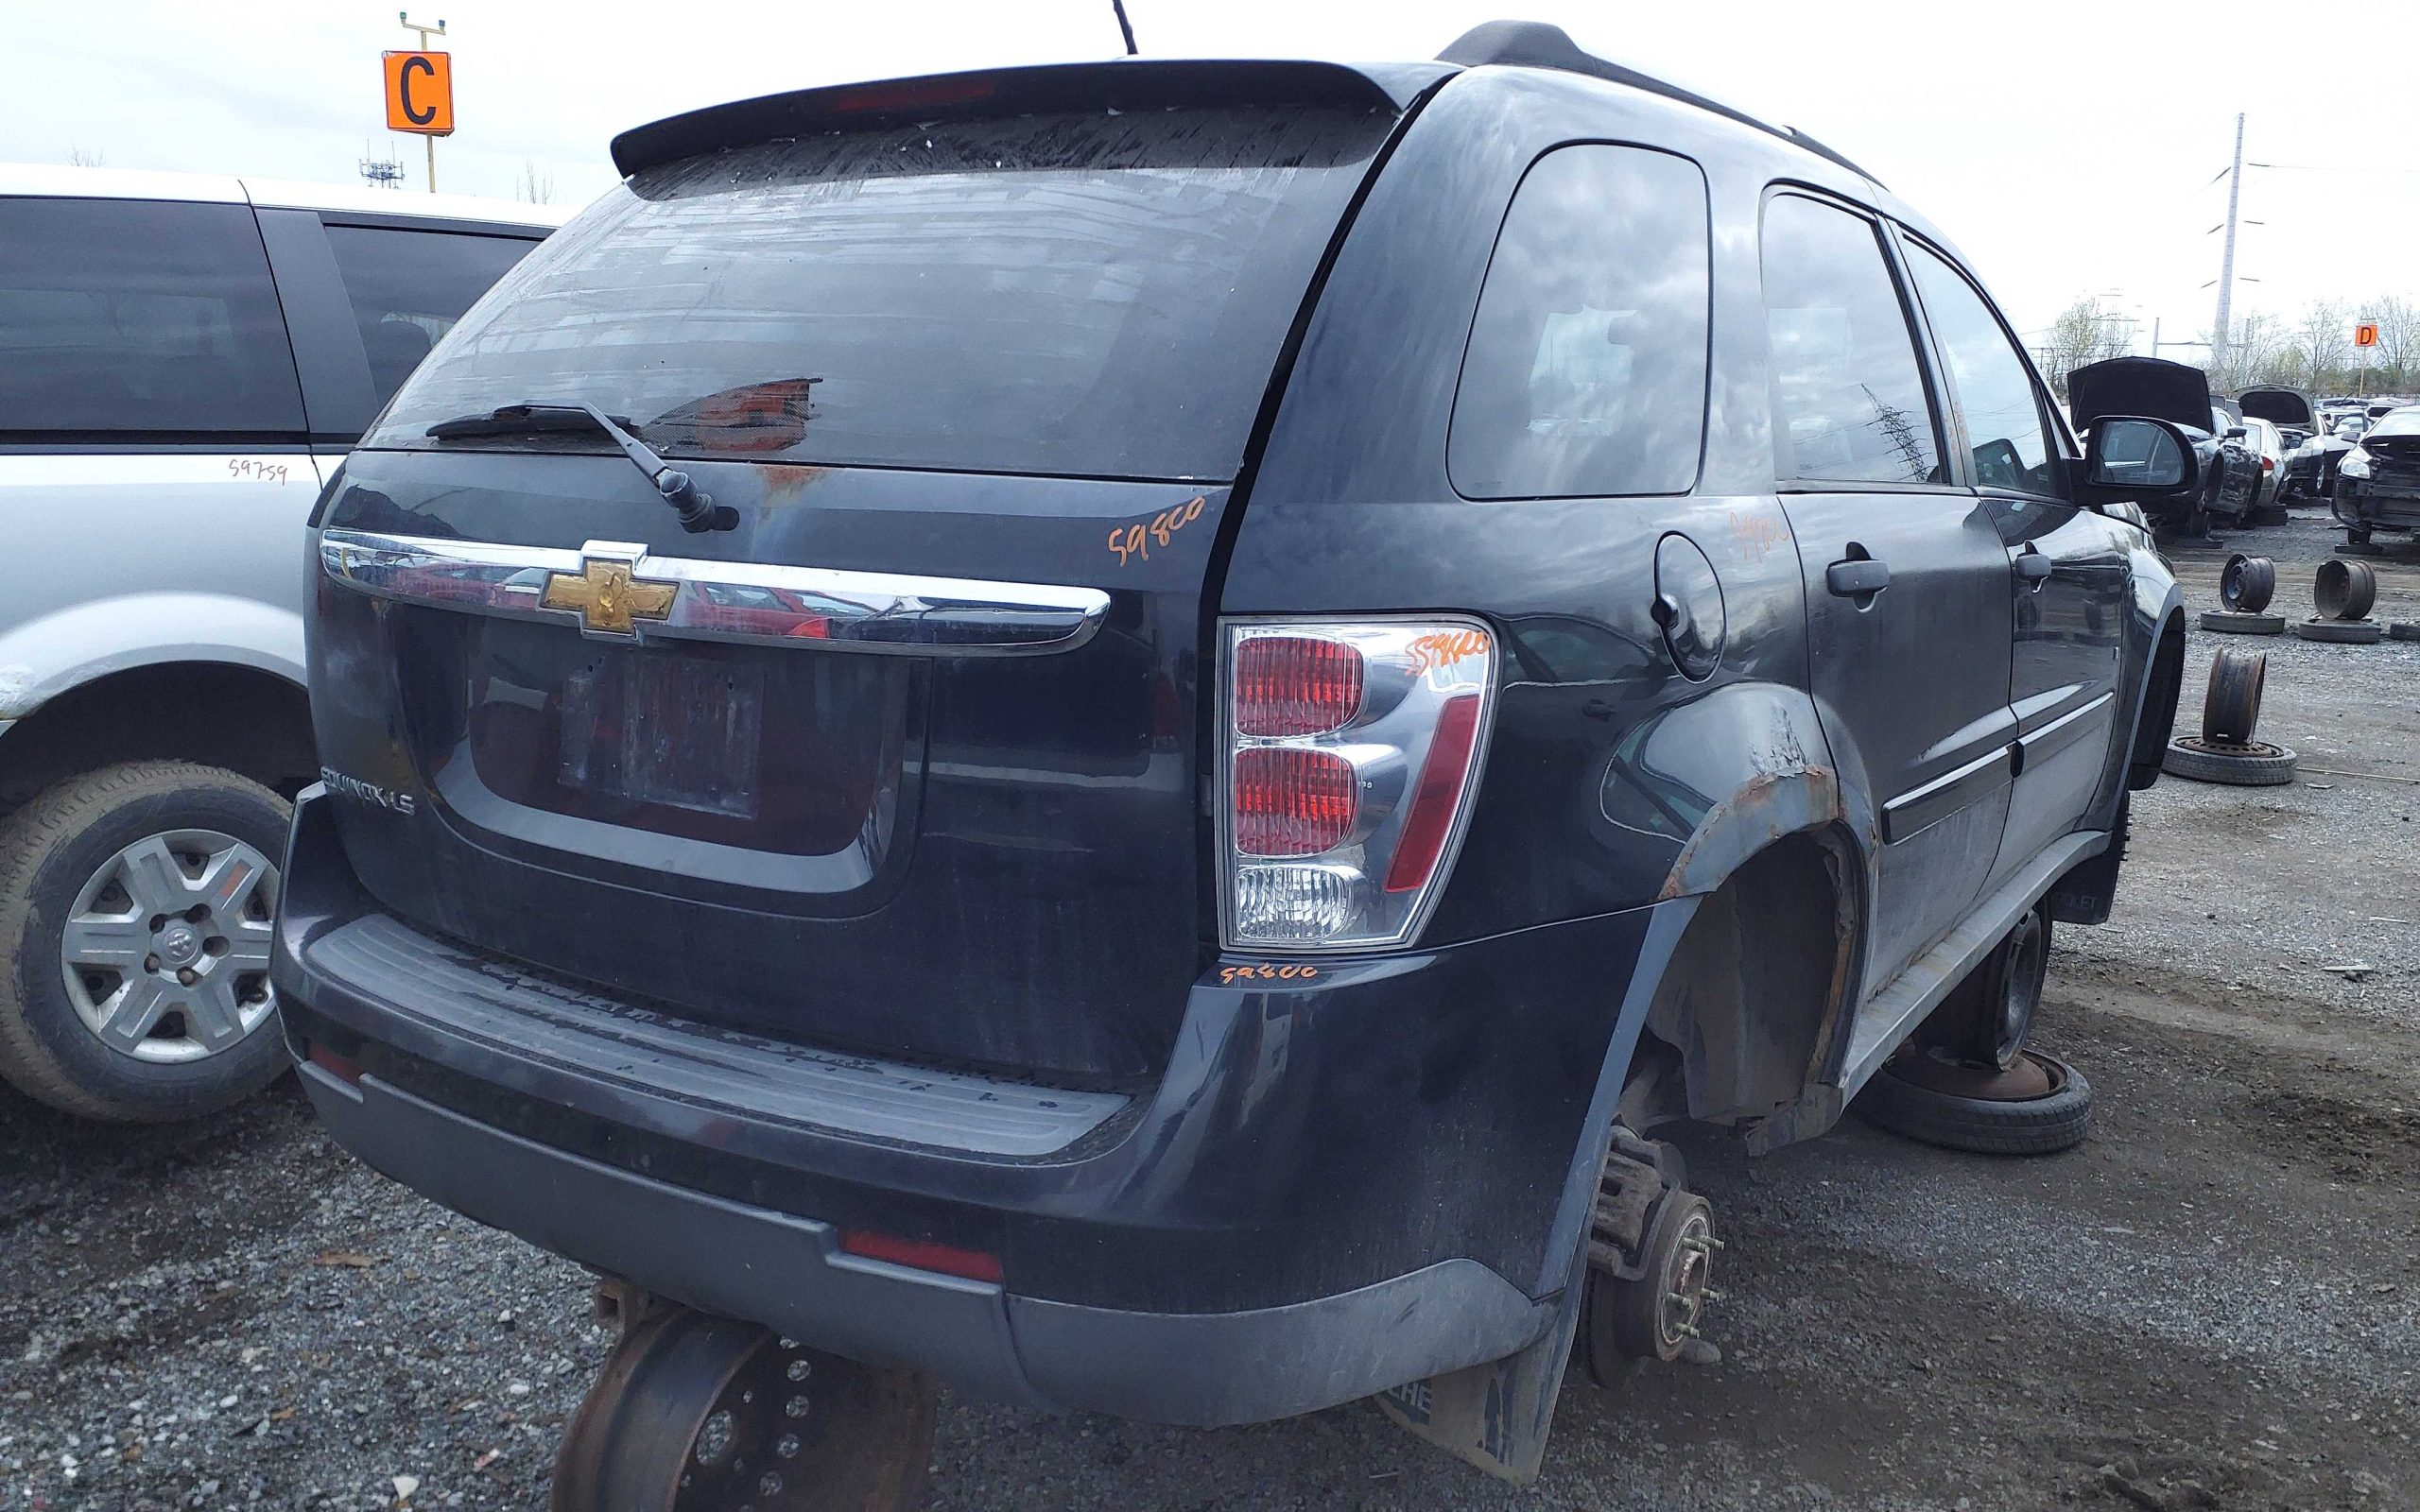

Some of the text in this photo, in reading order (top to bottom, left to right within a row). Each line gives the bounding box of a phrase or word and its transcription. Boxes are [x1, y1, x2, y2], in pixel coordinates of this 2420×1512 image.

[400, 56, 437, 126] C
[2360, 327, 2372, 345] D
[228, 458, 288, 487] 59759
